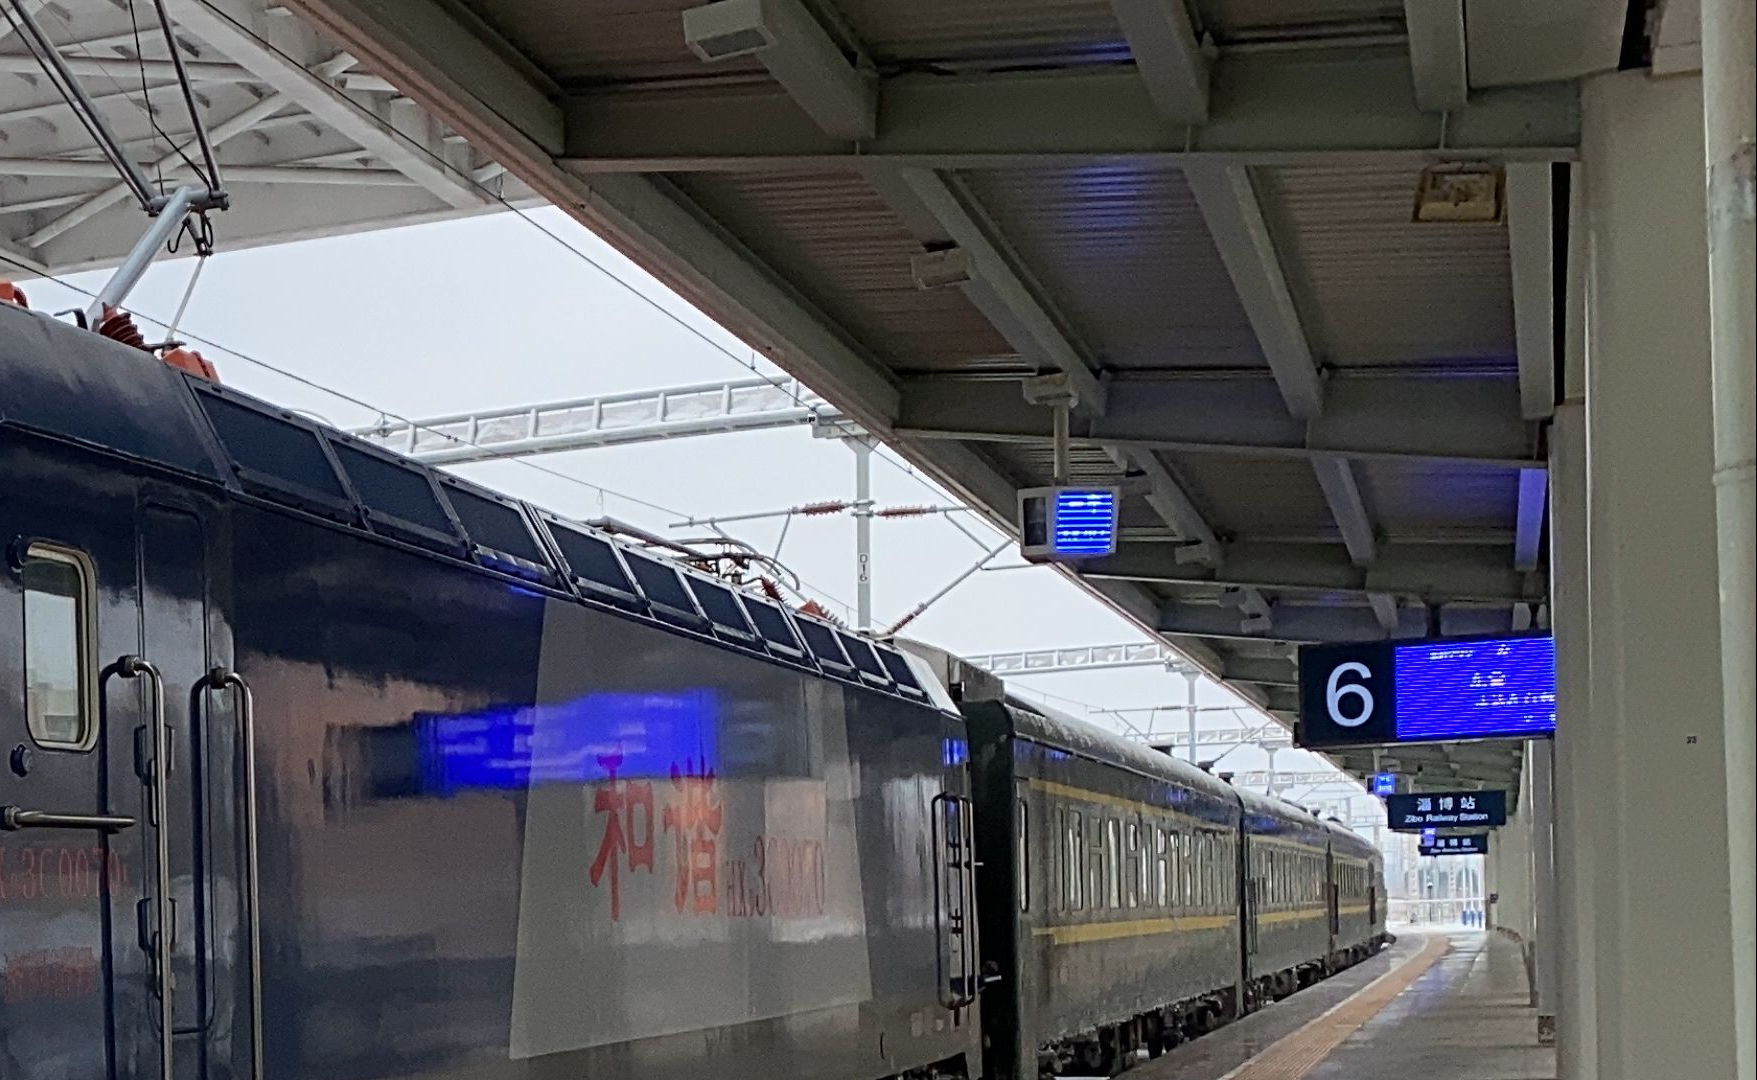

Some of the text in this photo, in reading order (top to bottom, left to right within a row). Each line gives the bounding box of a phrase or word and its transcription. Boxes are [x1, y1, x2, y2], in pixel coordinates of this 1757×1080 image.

[1326, 661, 1374, 727] 6
[1404, 812, 1488, 823] Zibo Railway Station
[1416, 796, 1476, 811] 淄博站
[589, 752, 723, 922] 和谐
